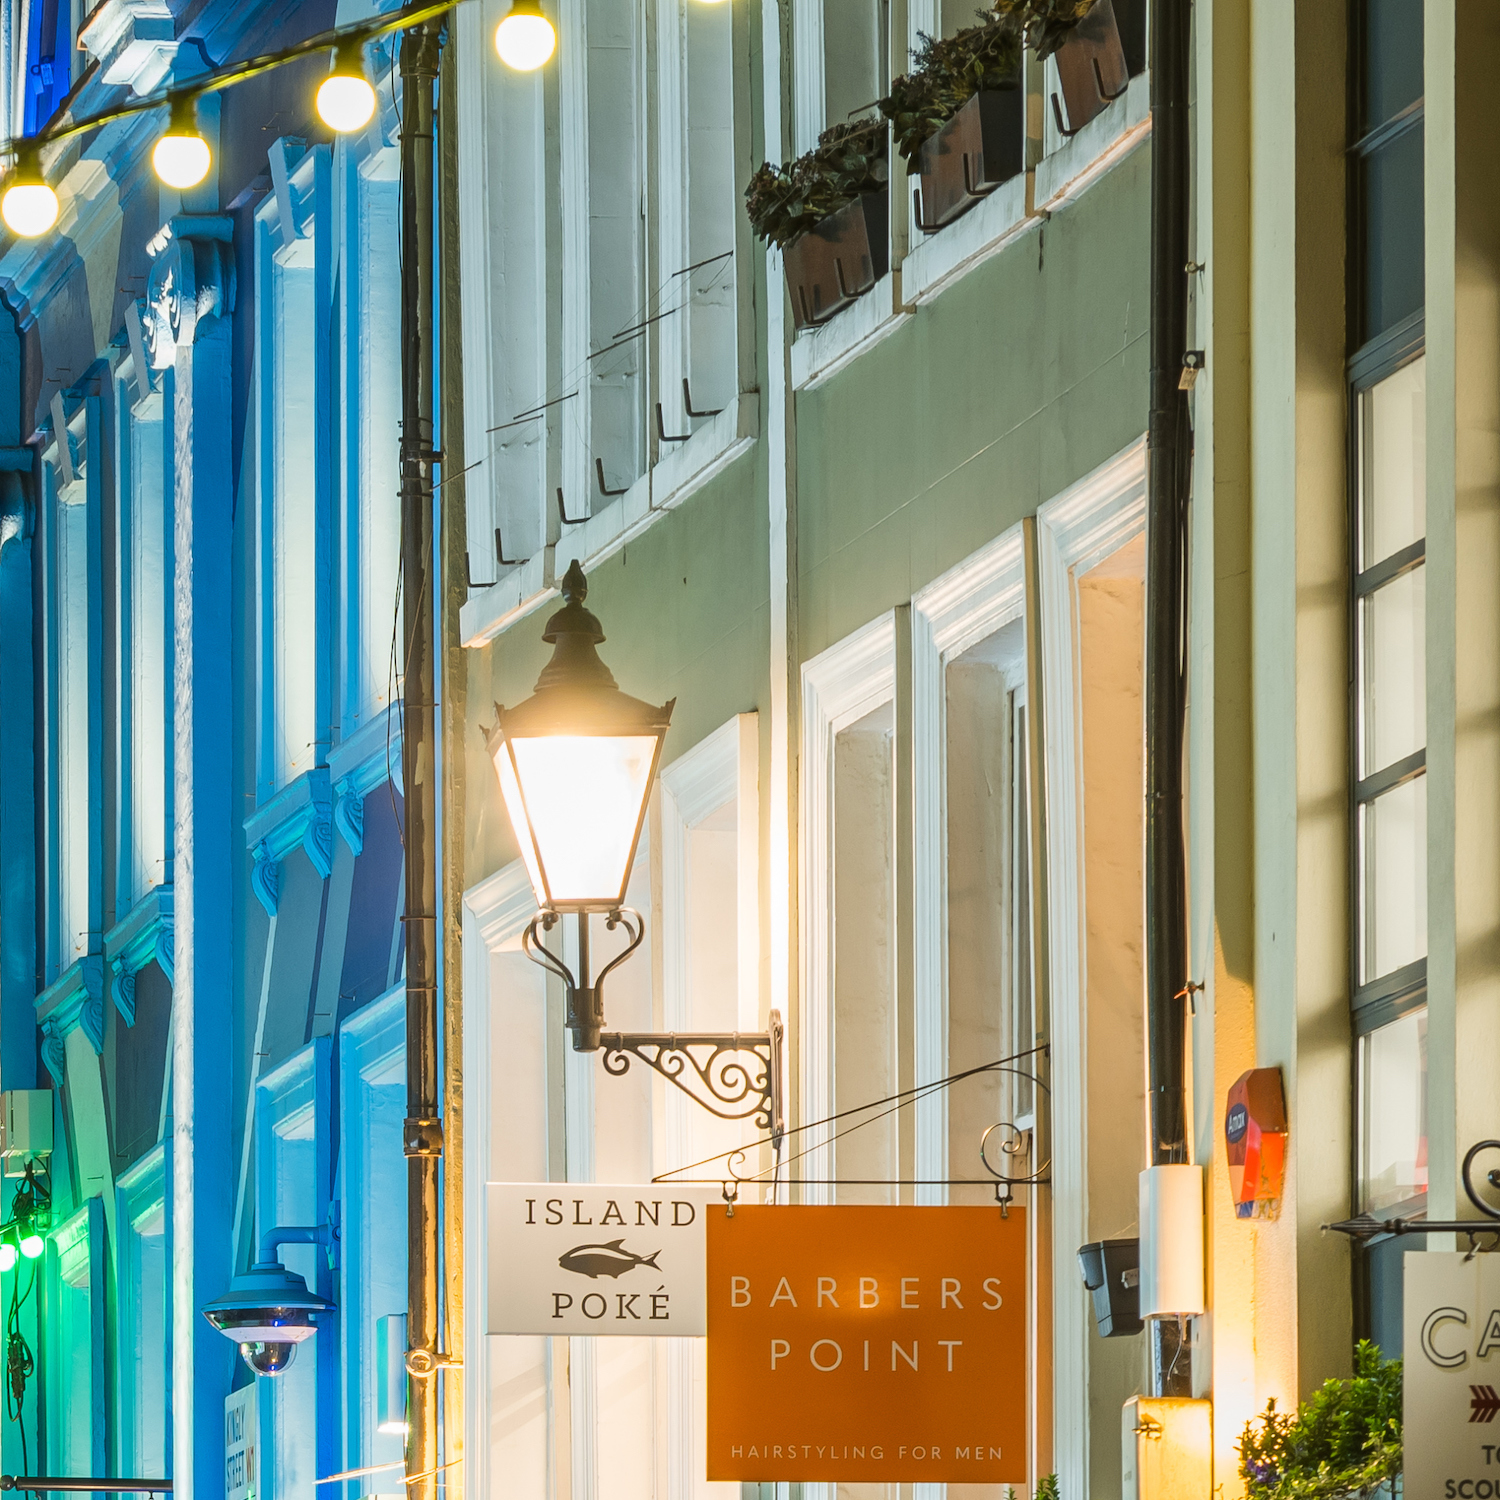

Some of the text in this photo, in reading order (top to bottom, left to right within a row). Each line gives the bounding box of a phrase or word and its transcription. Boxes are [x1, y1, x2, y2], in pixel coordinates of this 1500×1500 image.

[526, 1198, 697, 1227] ISLAND
[551, 1286, 671, 1321] POKÉ
[731, 1276, 1004, 1311] BARBERS
[769, 1338, 964, 1373] POINT
[731, 1444, 1004, 1461] HAIRSTYLING FOR MEN
